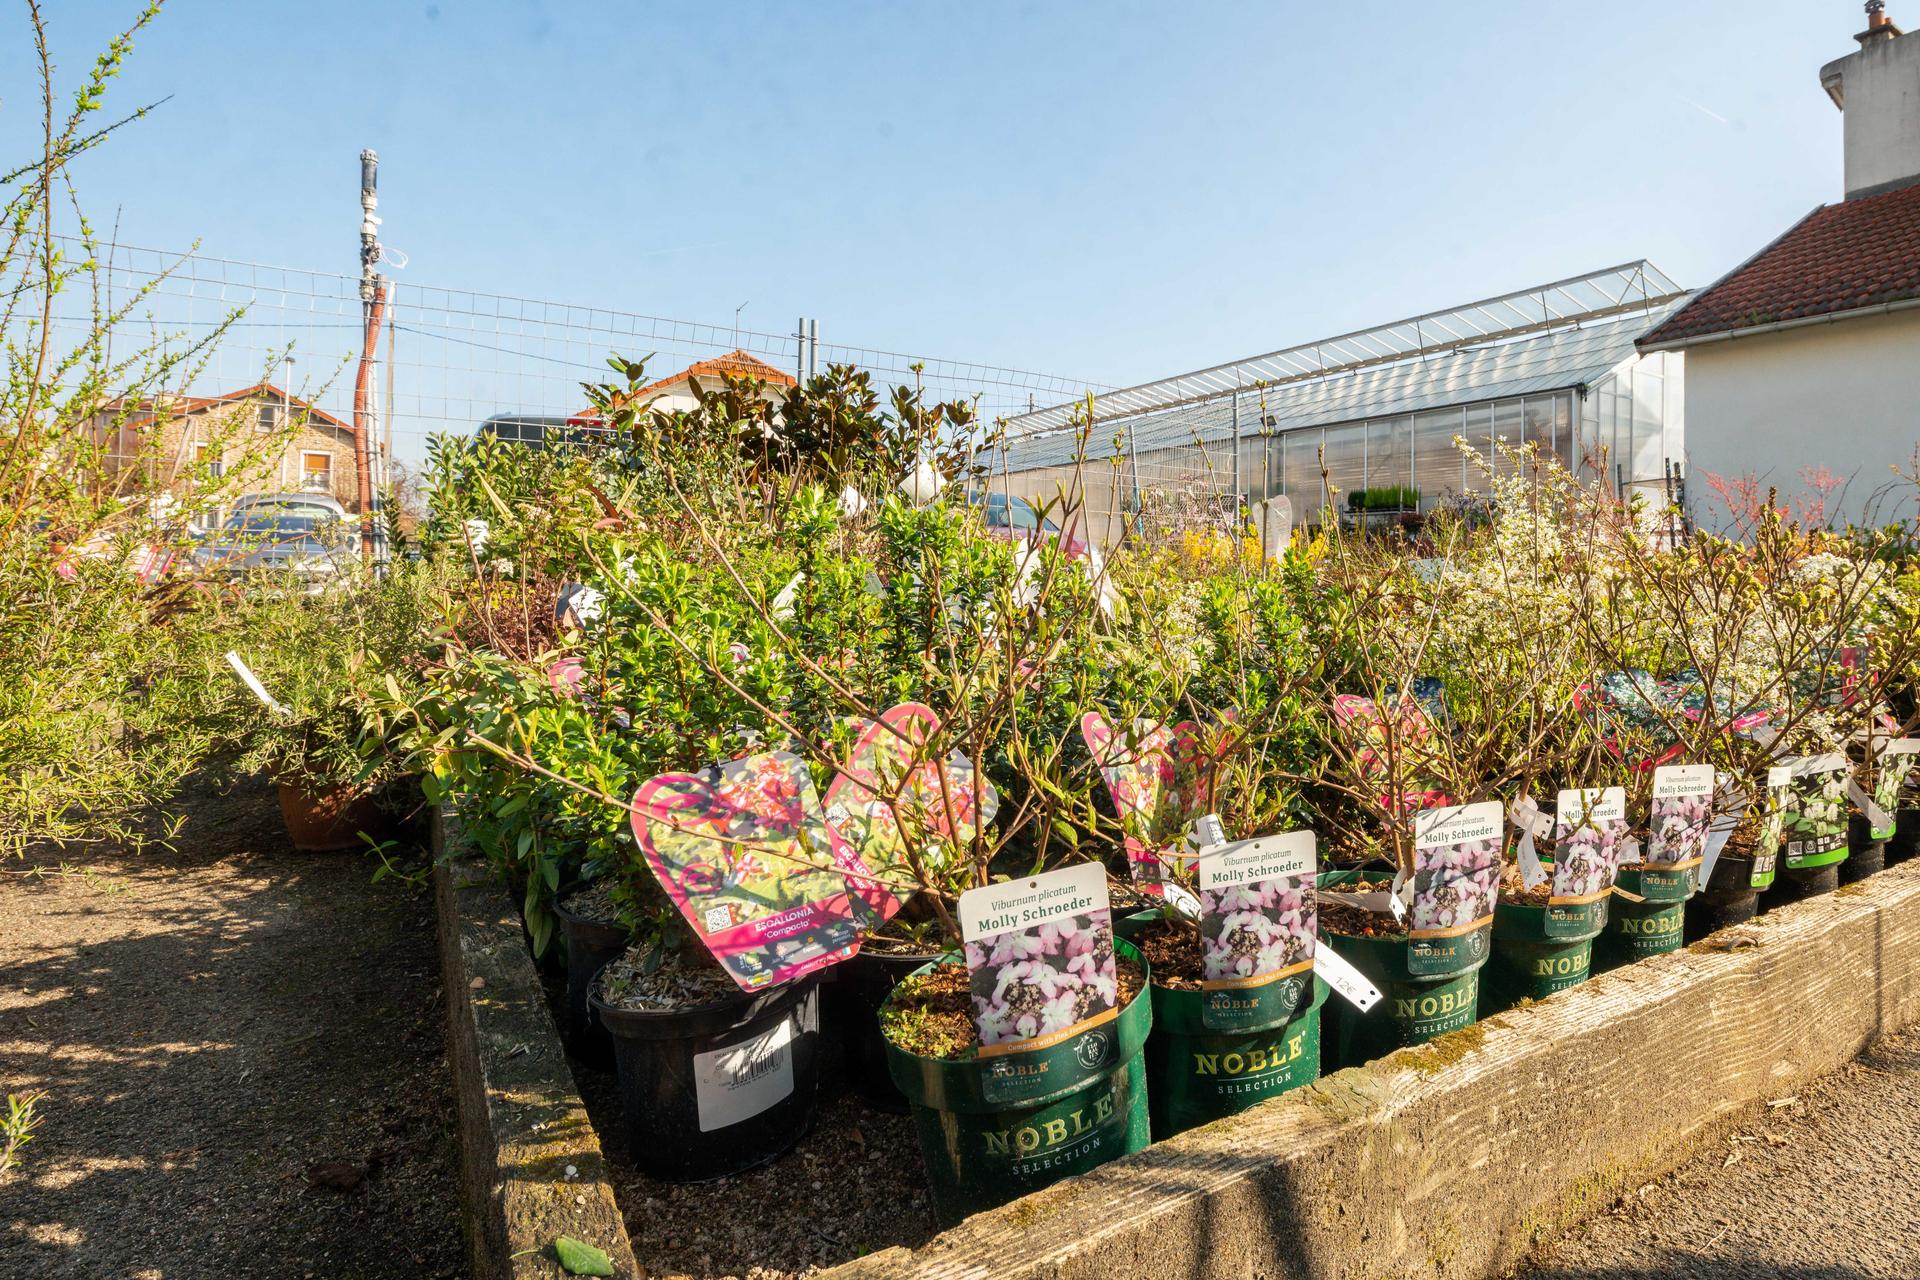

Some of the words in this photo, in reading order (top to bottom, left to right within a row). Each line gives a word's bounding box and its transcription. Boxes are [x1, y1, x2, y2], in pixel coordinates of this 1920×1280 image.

[1659, 786, 1676, 794] Molly
[1677, 784, 1706, 792] Schroeder
[1425, 832, 1450, 844] Molly
[1452, 826, 1494, 840] Schroeder
[1223, 855, 1260, 867] Viburnum
[1260, 850, 1292, 863] plicatum
[1212, 870, 1244, 884] Molly
[1248, 860, 1304, 878] Schroeder
[991, 892, 1037, 912] Viburnum
[1038, 884, 1077, 903] plicatum
[755, 907, 814, 932] ESCALLONIA
[978, 915, 1018, 932] Molly
[1022, 896, 1093, 922] Schroeder
[1414, 947, 1456, 958] NOBLE
[1536, 951, 1589, 976] NOBL
[1210, 998, 1259, 1010] NOBLE
[1396, 980, 1475, 1017] NOBLE
[1414, 1012, 1469, 1034] SELECTION
[1008, 1040, 1038, 1052] Compact
[1194, 1034, 1302, 1075] NOBLE
[992, 1062, 1049, 1079] NOBLE
[1218, 1072, 1292, 1094] SELECTION
[982, 1092, 1113, 1155] NOBLE
[1012, 1138, 1101, 1176] SELECTION
